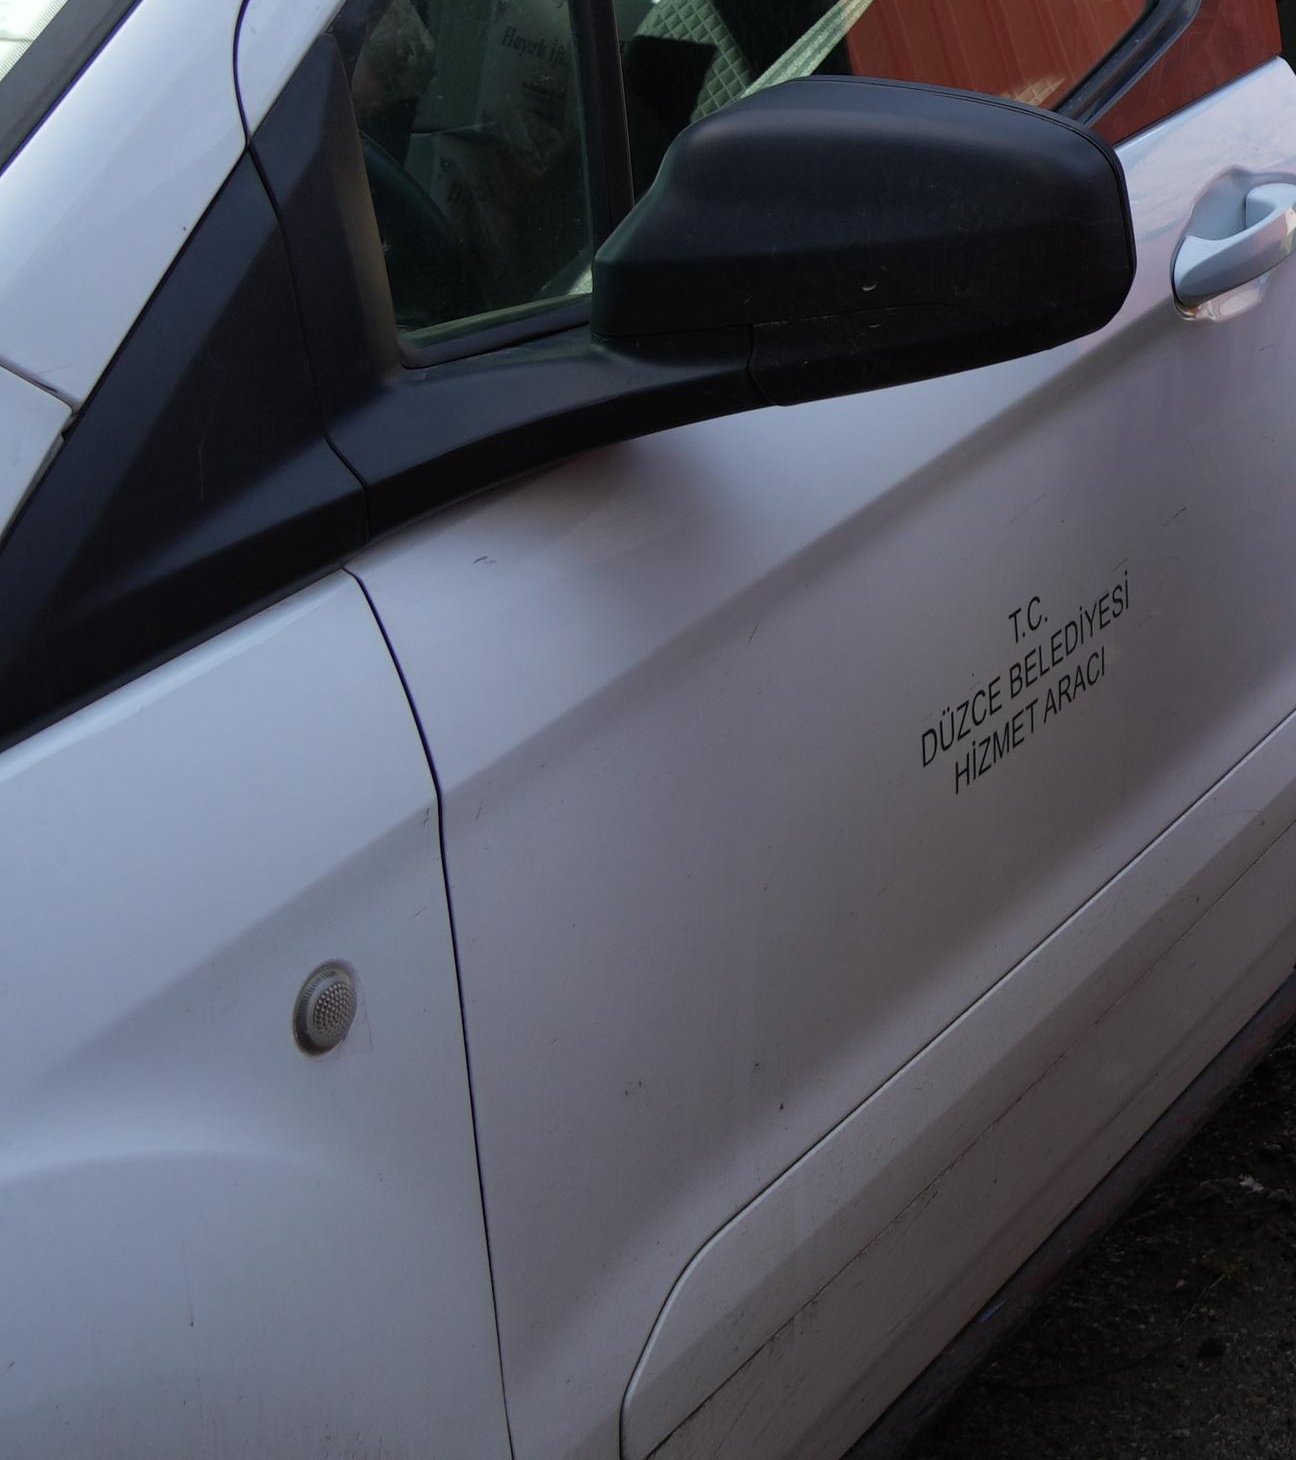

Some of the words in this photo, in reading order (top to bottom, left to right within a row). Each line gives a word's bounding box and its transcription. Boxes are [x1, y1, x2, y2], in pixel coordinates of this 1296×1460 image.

[921, 676, 1002, 767] DÜZCE
[1009, 569, 1129, 699] BELEDİYESİ
[1008, 595, 1048, 643] T.C.
[955, 698, 1039, 794] HİZMET
[1043, 645, 1105, 724] ARACI
